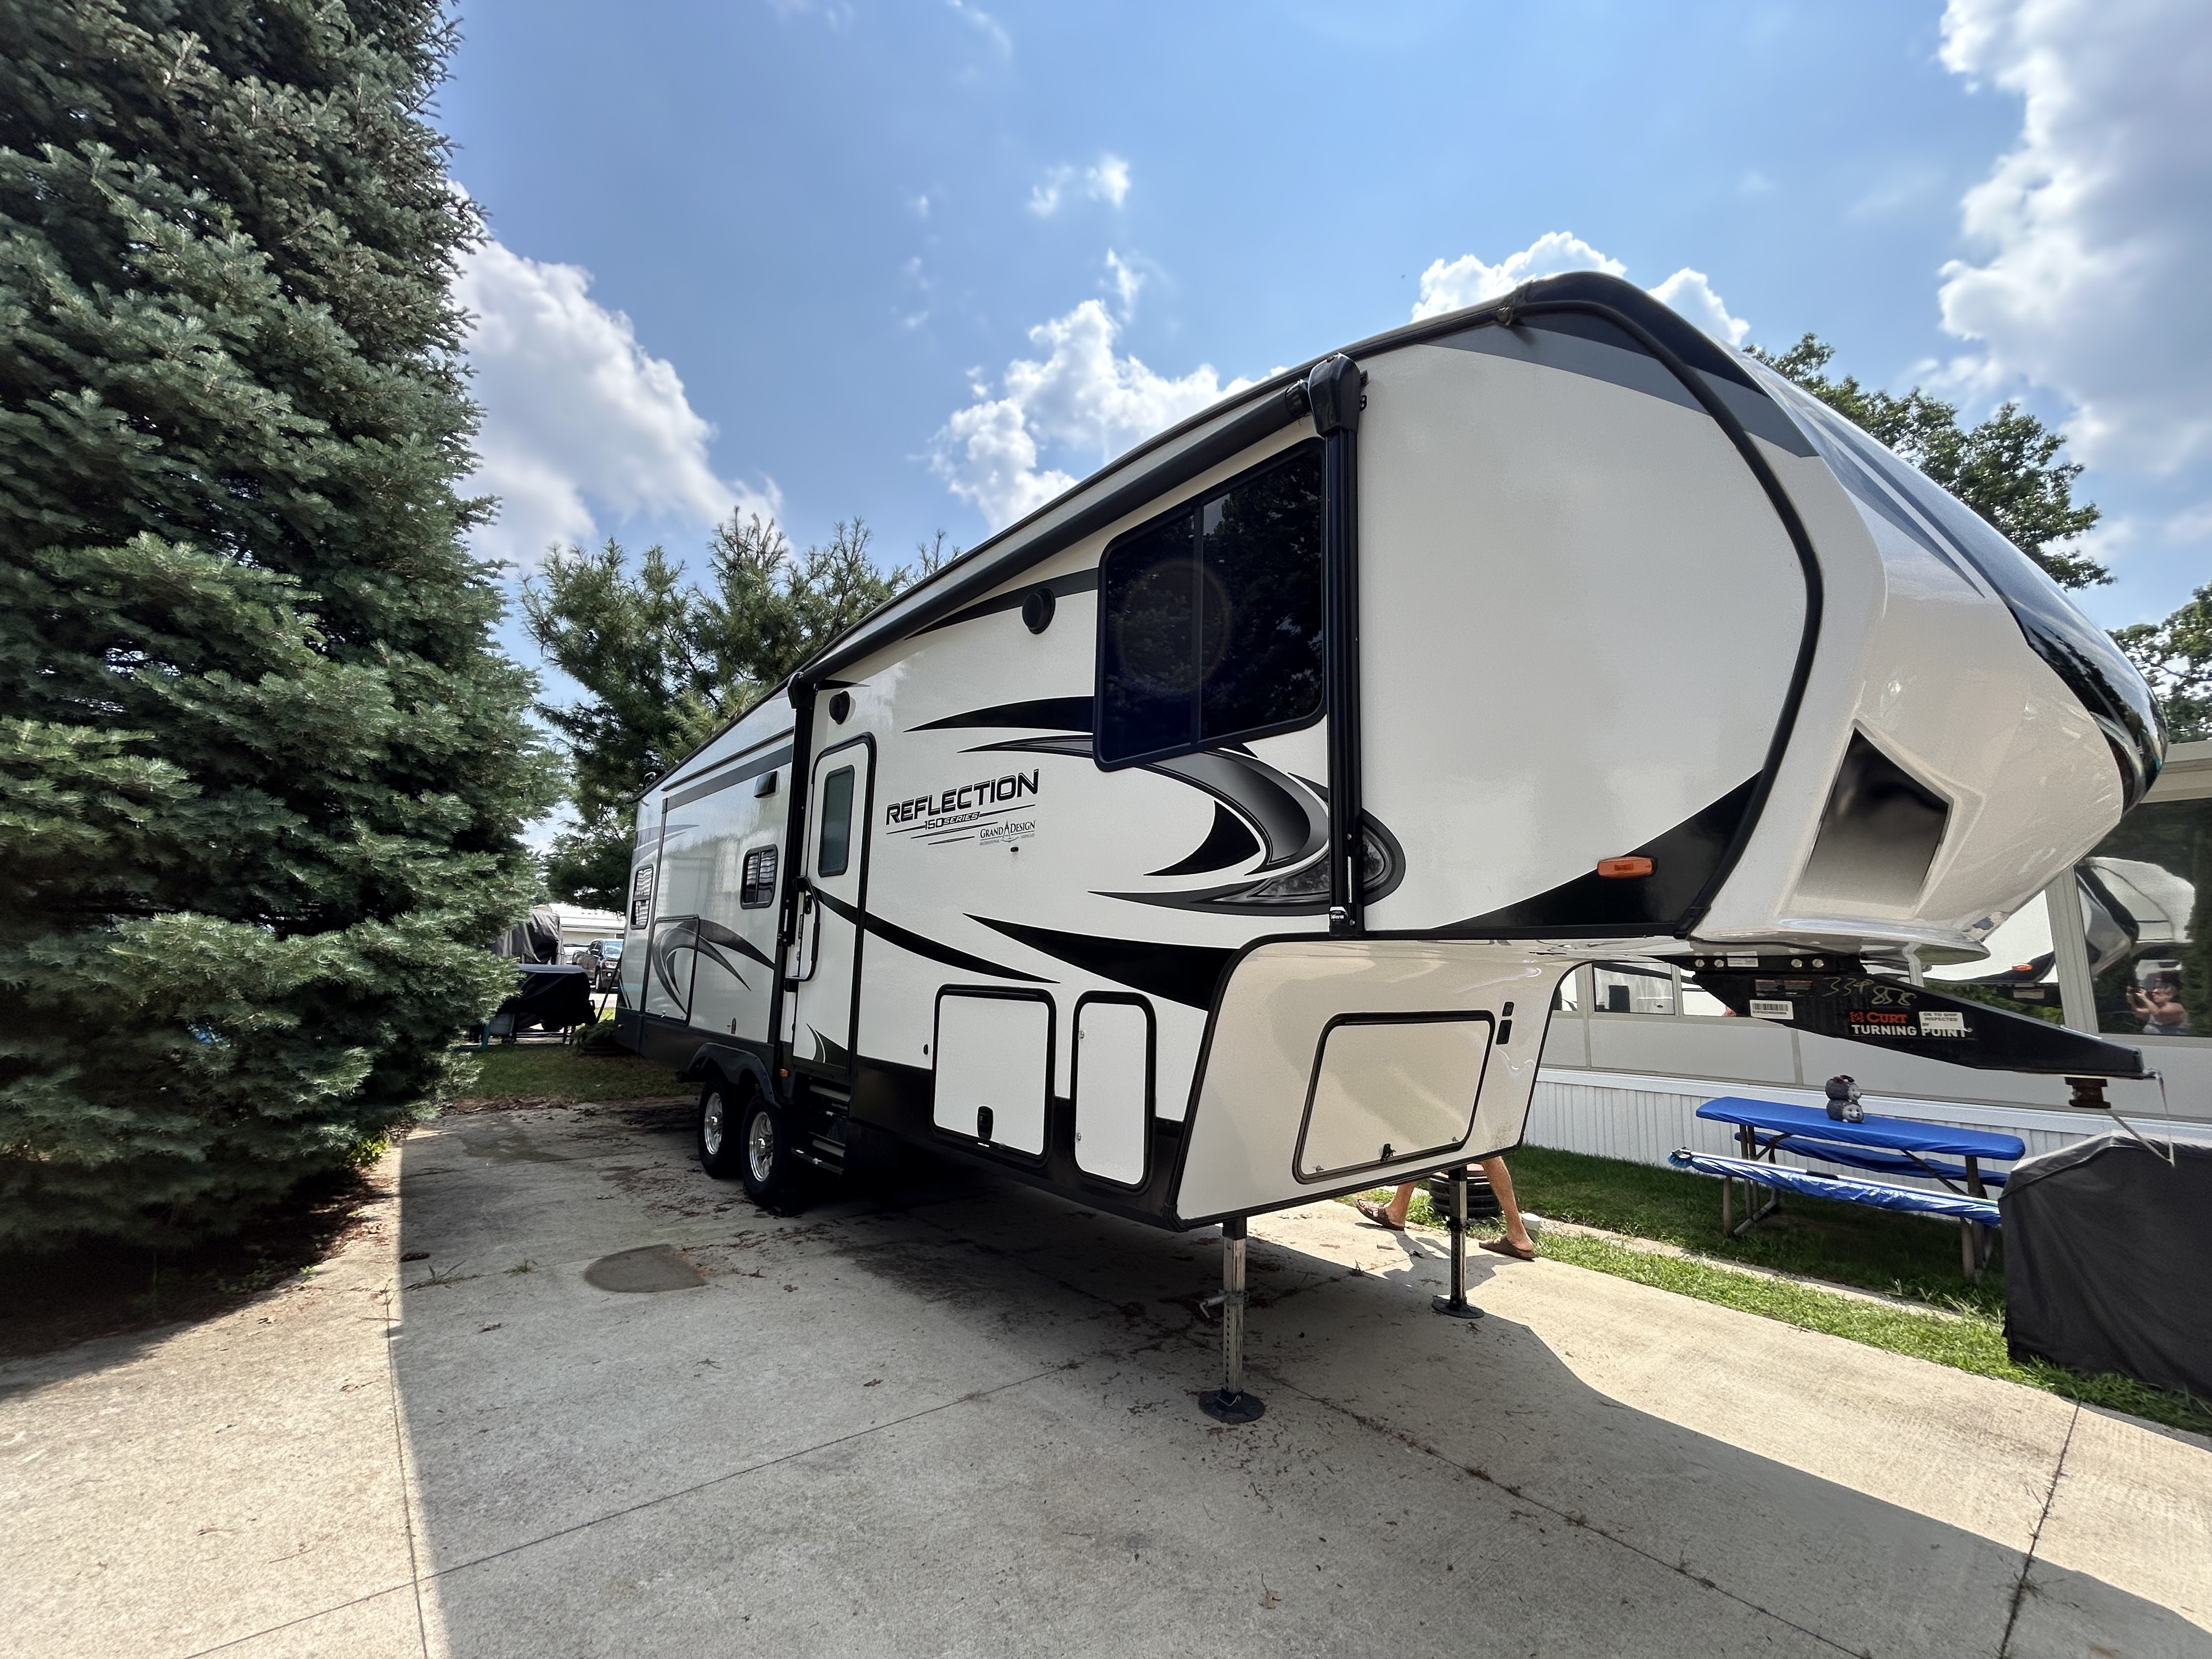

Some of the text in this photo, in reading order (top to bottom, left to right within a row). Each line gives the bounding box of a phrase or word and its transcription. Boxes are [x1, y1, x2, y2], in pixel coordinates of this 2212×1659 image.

[886, 769, 1039, 825] REFLECTION
[924, 812, 979, 830] 150 SERIES
[980, 821, 1036, 838] GRAND DESIGN
[1851, 1024, 1966, 1037] TURNING POINT
